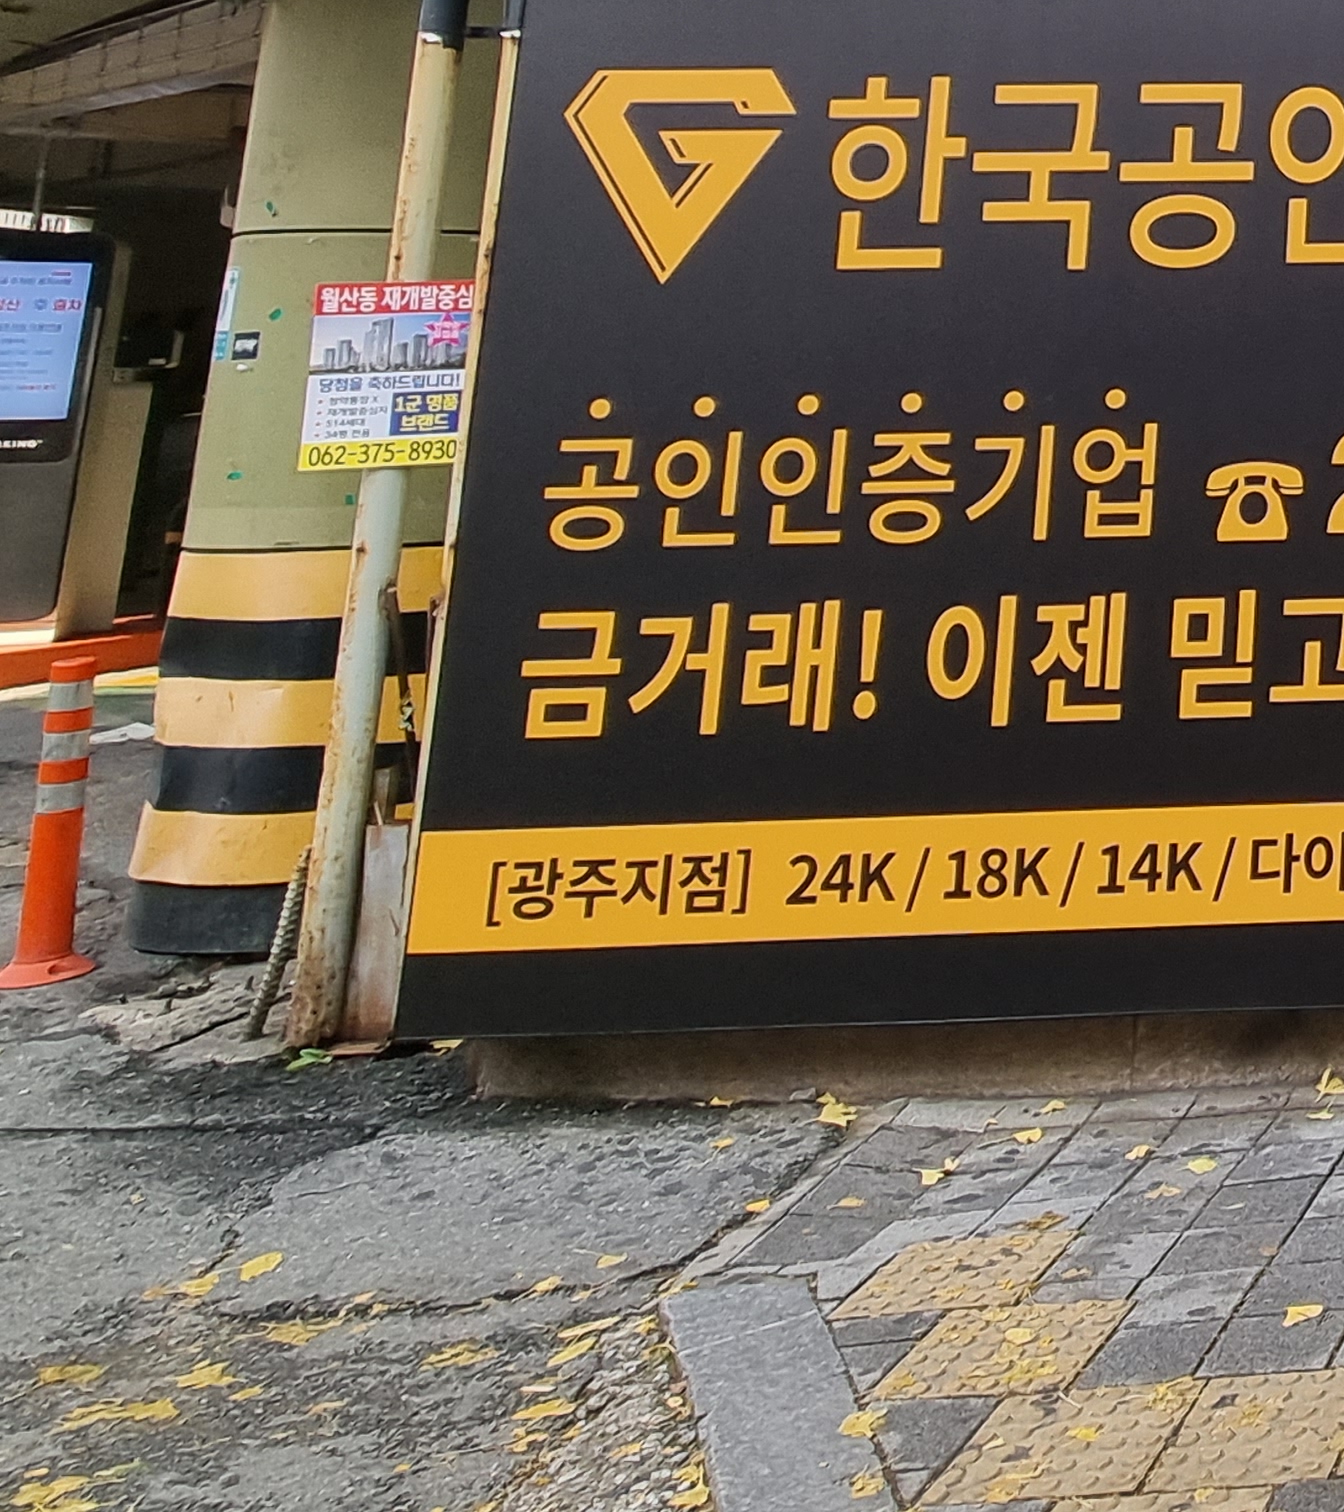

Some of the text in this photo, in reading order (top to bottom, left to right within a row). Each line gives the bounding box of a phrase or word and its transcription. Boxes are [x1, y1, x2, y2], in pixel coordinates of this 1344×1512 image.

[320, 286, 378, 313] 월산동
[400, 413, 450, 432] 브랜드
[308, 439, 457, 467] 062-375-8930
[543, 389, 1159, 553] 공인인증기업
[520, 598, 884, 740] 금거래!
[925, 591, 1128, 728] 이젠
[485, 849, 752, 927] [광주지점]
